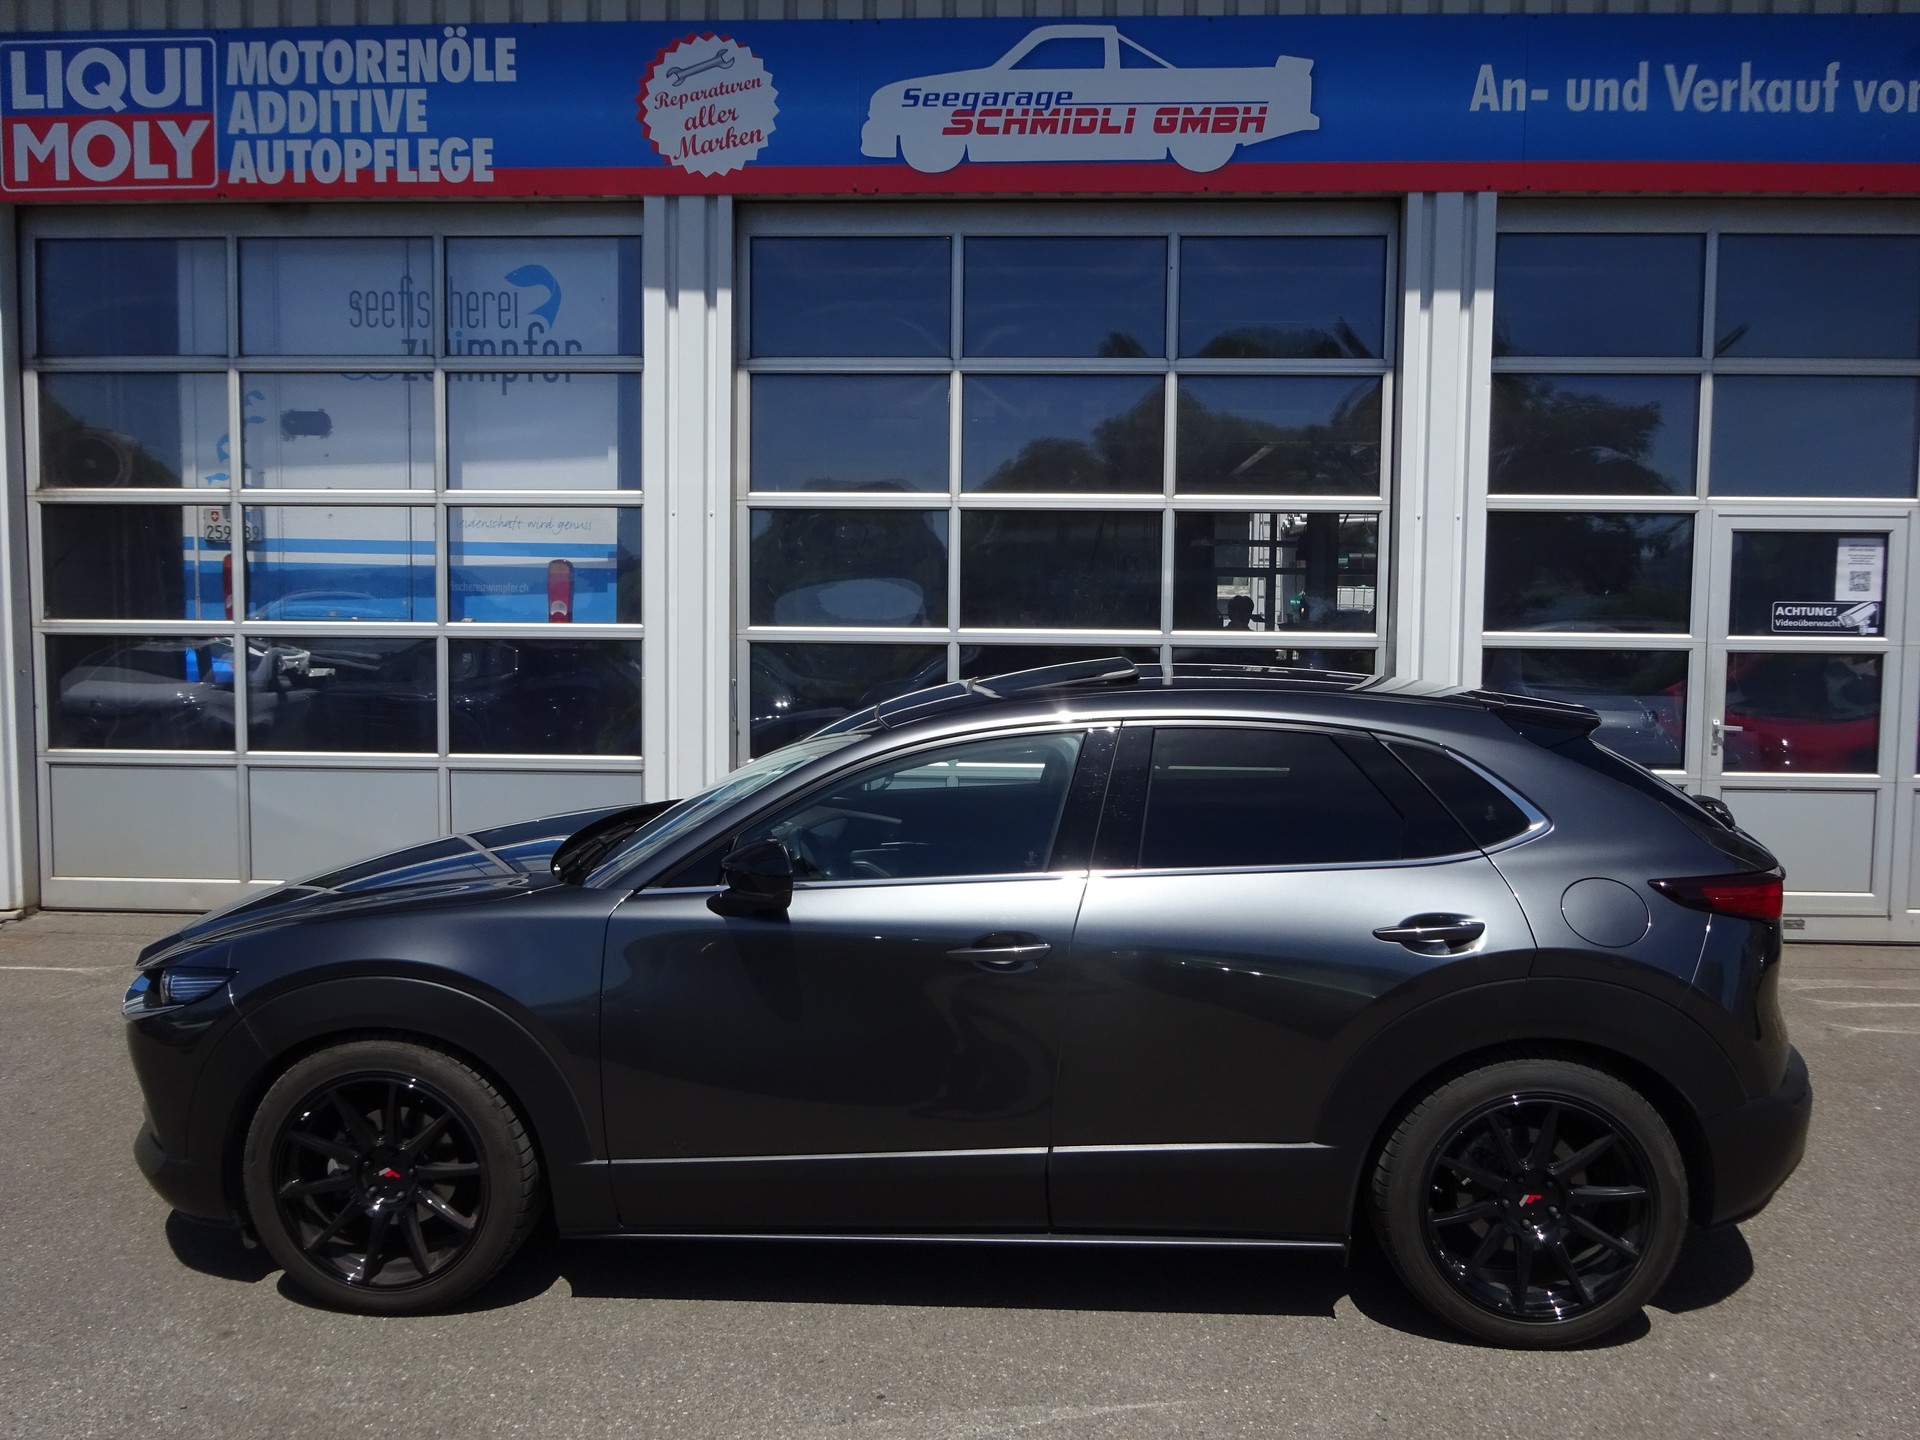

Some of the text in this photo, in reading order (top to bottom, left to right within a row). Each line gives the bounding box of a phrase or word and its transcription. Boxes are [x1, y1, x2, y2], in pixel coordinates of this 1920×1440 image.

[226, 26, 517, 85] MOTORENÖLE
[10, 47, 203, 113] LIQUI
[654, 77, 763, 110] Reparaturen
[1469, 64, 1549, 112] An-
[1566, 61, 1649, 112] und
[1664, 61, 1841, 113] Verkauf
[226, 89, 427, 134] ADDITIVE
[901, 88, 1073, 111] Seegarage
[684, 103, 739, 131] aller
[942, 106, 1268, 136] SCHMIDLI GMBH
[12, 120, 211, 182] MOLY
[673, 126, 765, 160] Marken
[226, 138, 495, 184] AUTOPFLEGE
[350, 275, 518, 328] seefisherei
[206, 524, 260, 541] 25989
[527, 518, 554, 530] wird
[553, 519, 592, 535] genuss
[1775, 606, 1837, 616] ACHTUNG!
[1775, 619, 1841, 627] Videoüberwacht
